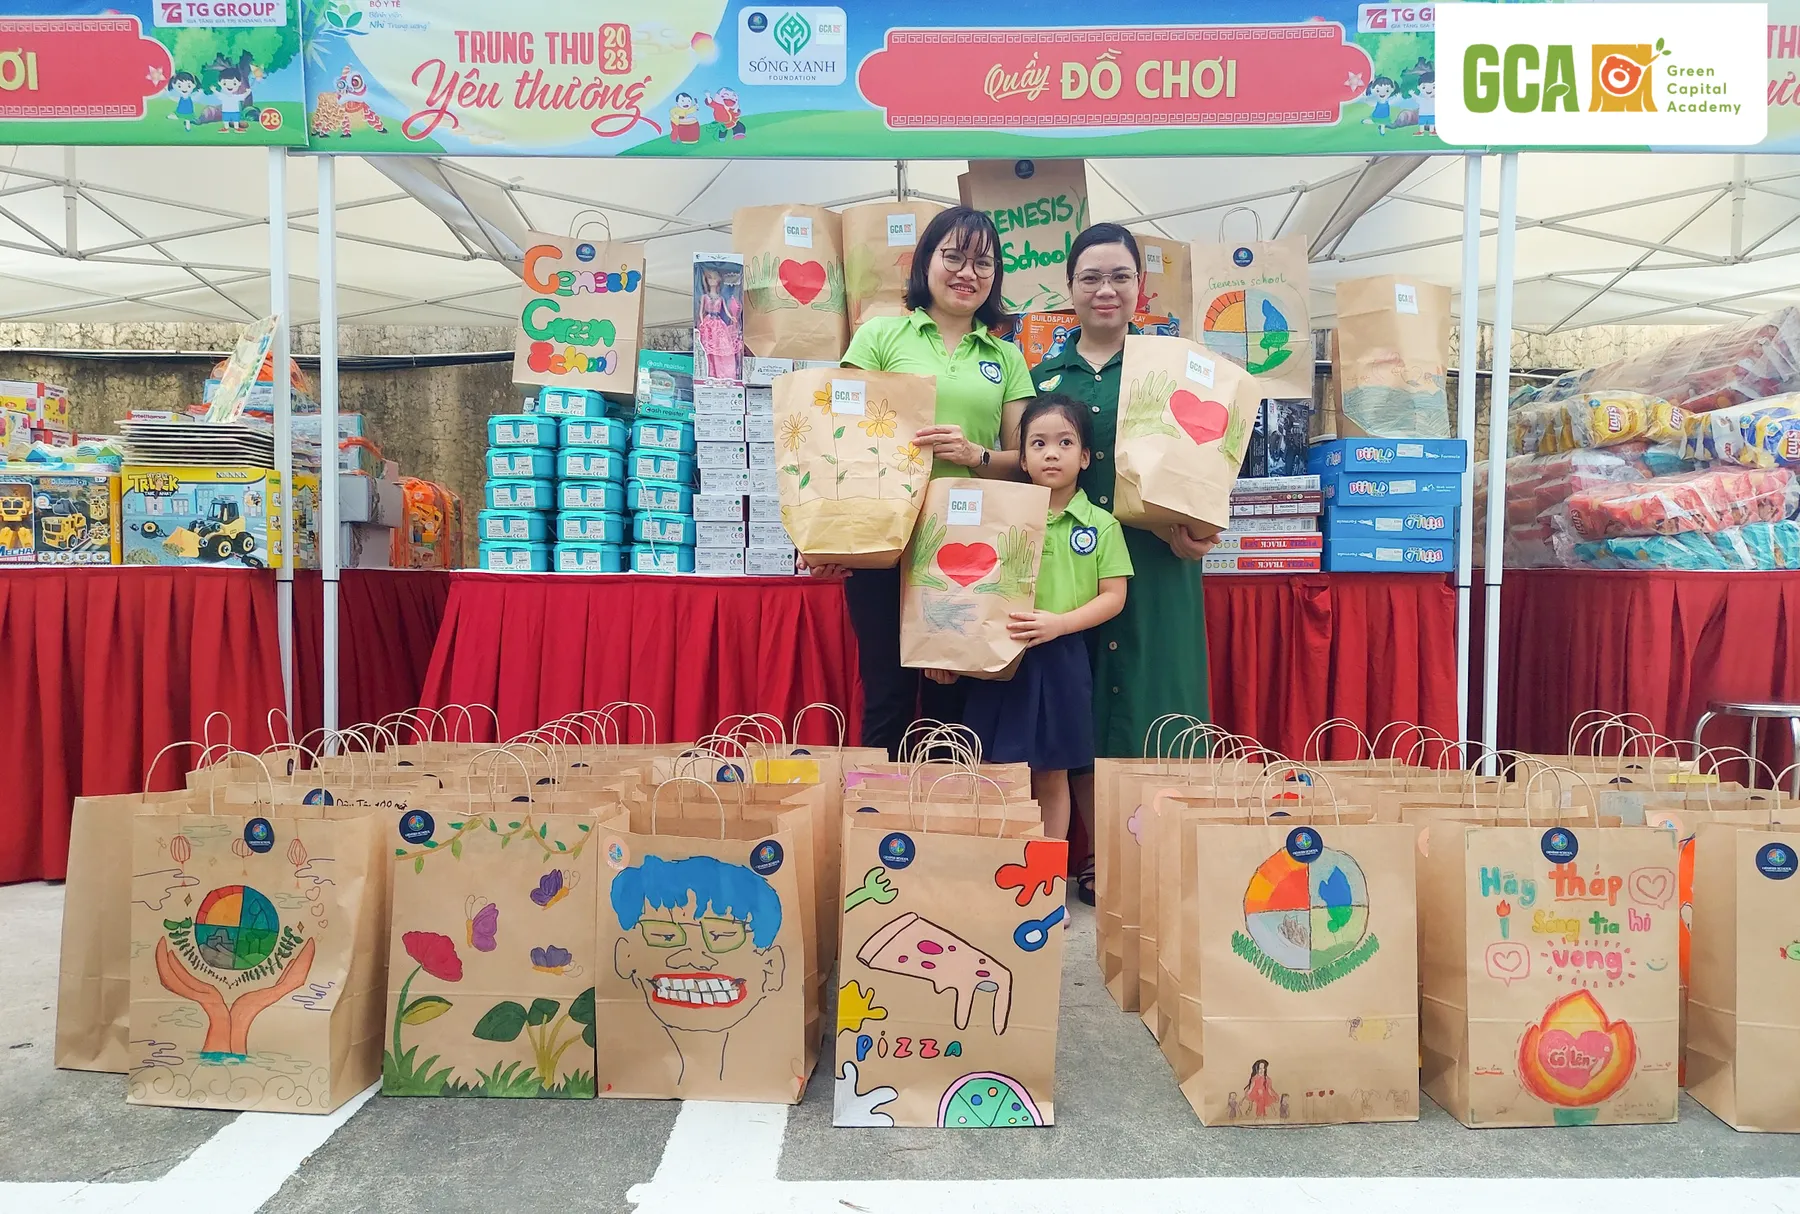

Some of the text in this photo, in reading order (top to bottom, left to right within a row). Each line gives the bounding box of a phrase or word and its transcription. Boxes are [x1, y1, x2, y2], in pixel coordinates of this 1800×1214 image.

[186, 3, 276, 16] TG GROUP
[1391, 8, 1435, 21] TG G
[604, 26, 626, 49] 20
[454, 30, 595, 66] TRUNG THU
[603, 49, 629, 71] 23
[749, 56, 836, 73] SỐNG XANH
[983, 47, 1238, 102] Quầy ĐỒ CHƠI
[402, 58, 662, 141] Yêu thương
[263, 112, 282, 128] 28
[890, 224, 904, 234] GCA
[1208, 273, 1287, 290] Genesis school
[1031, 314, 1075, 324] BUILD&PLAY
[834, 390, 851, 401] GCA
[951, 500, 967, 511] GCA
[1478, 866, 1538, 909] Hãy
[1532, 908, 1652, 942] Sáng tia hi
[1569, 1046, 1591, 1069] lên
